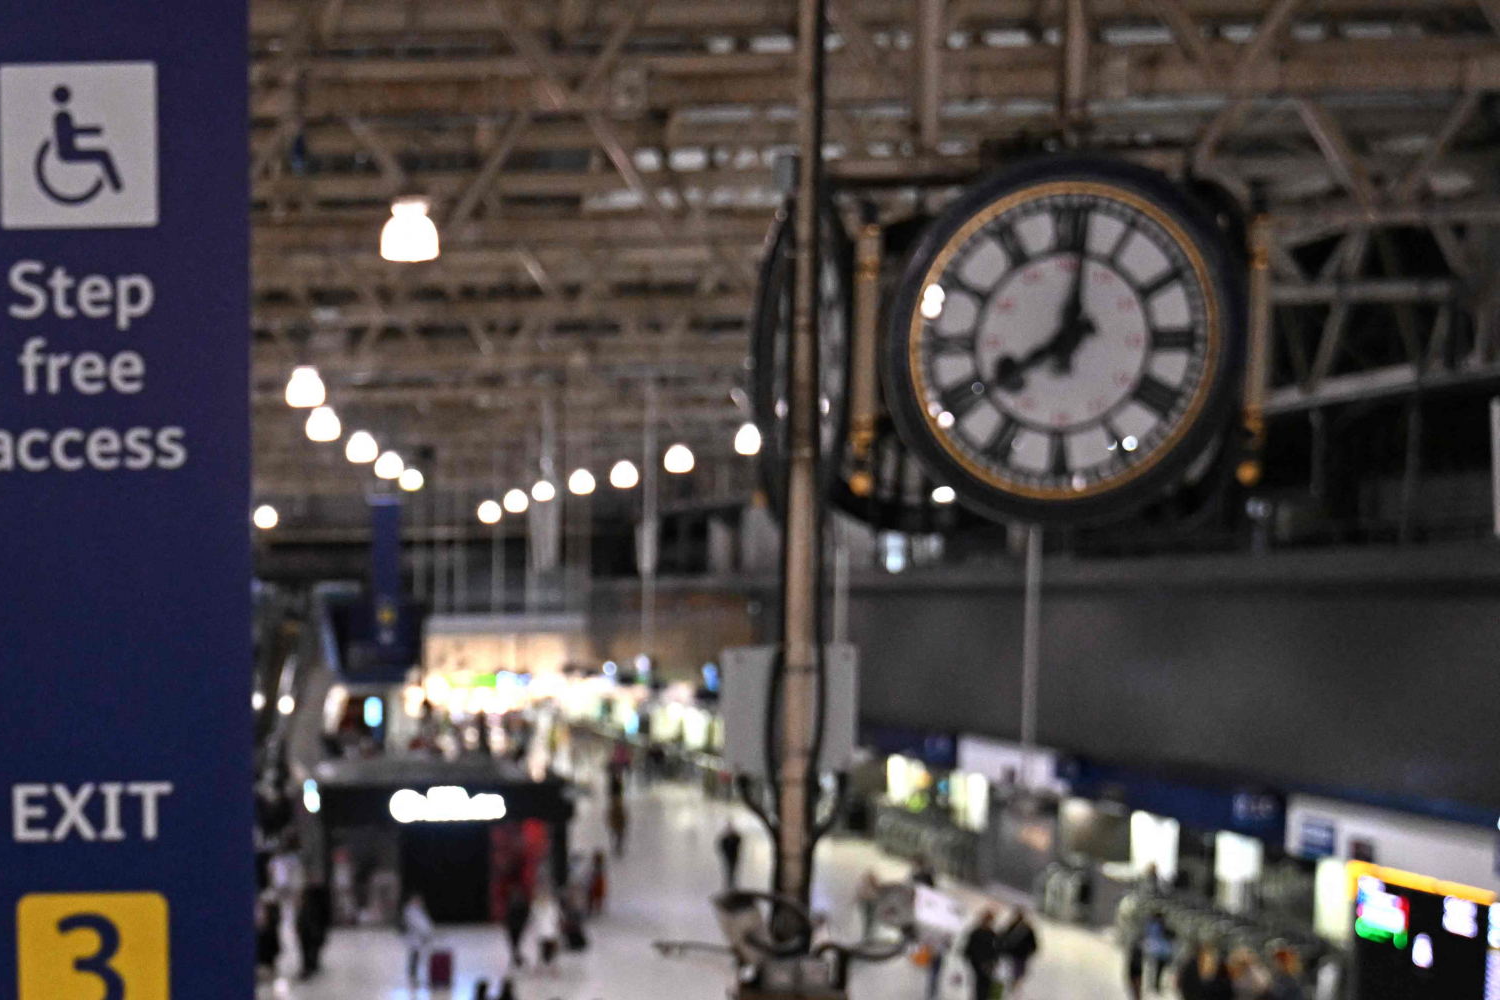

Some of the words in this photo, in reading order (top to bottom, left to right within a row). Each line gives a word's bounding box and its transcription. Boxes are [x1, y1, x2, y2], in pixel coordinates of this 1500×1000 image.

[8, 260, 154, 331] Step
[18, 336, 146, 395] free
[12, 781, 174, 842] EXIT
